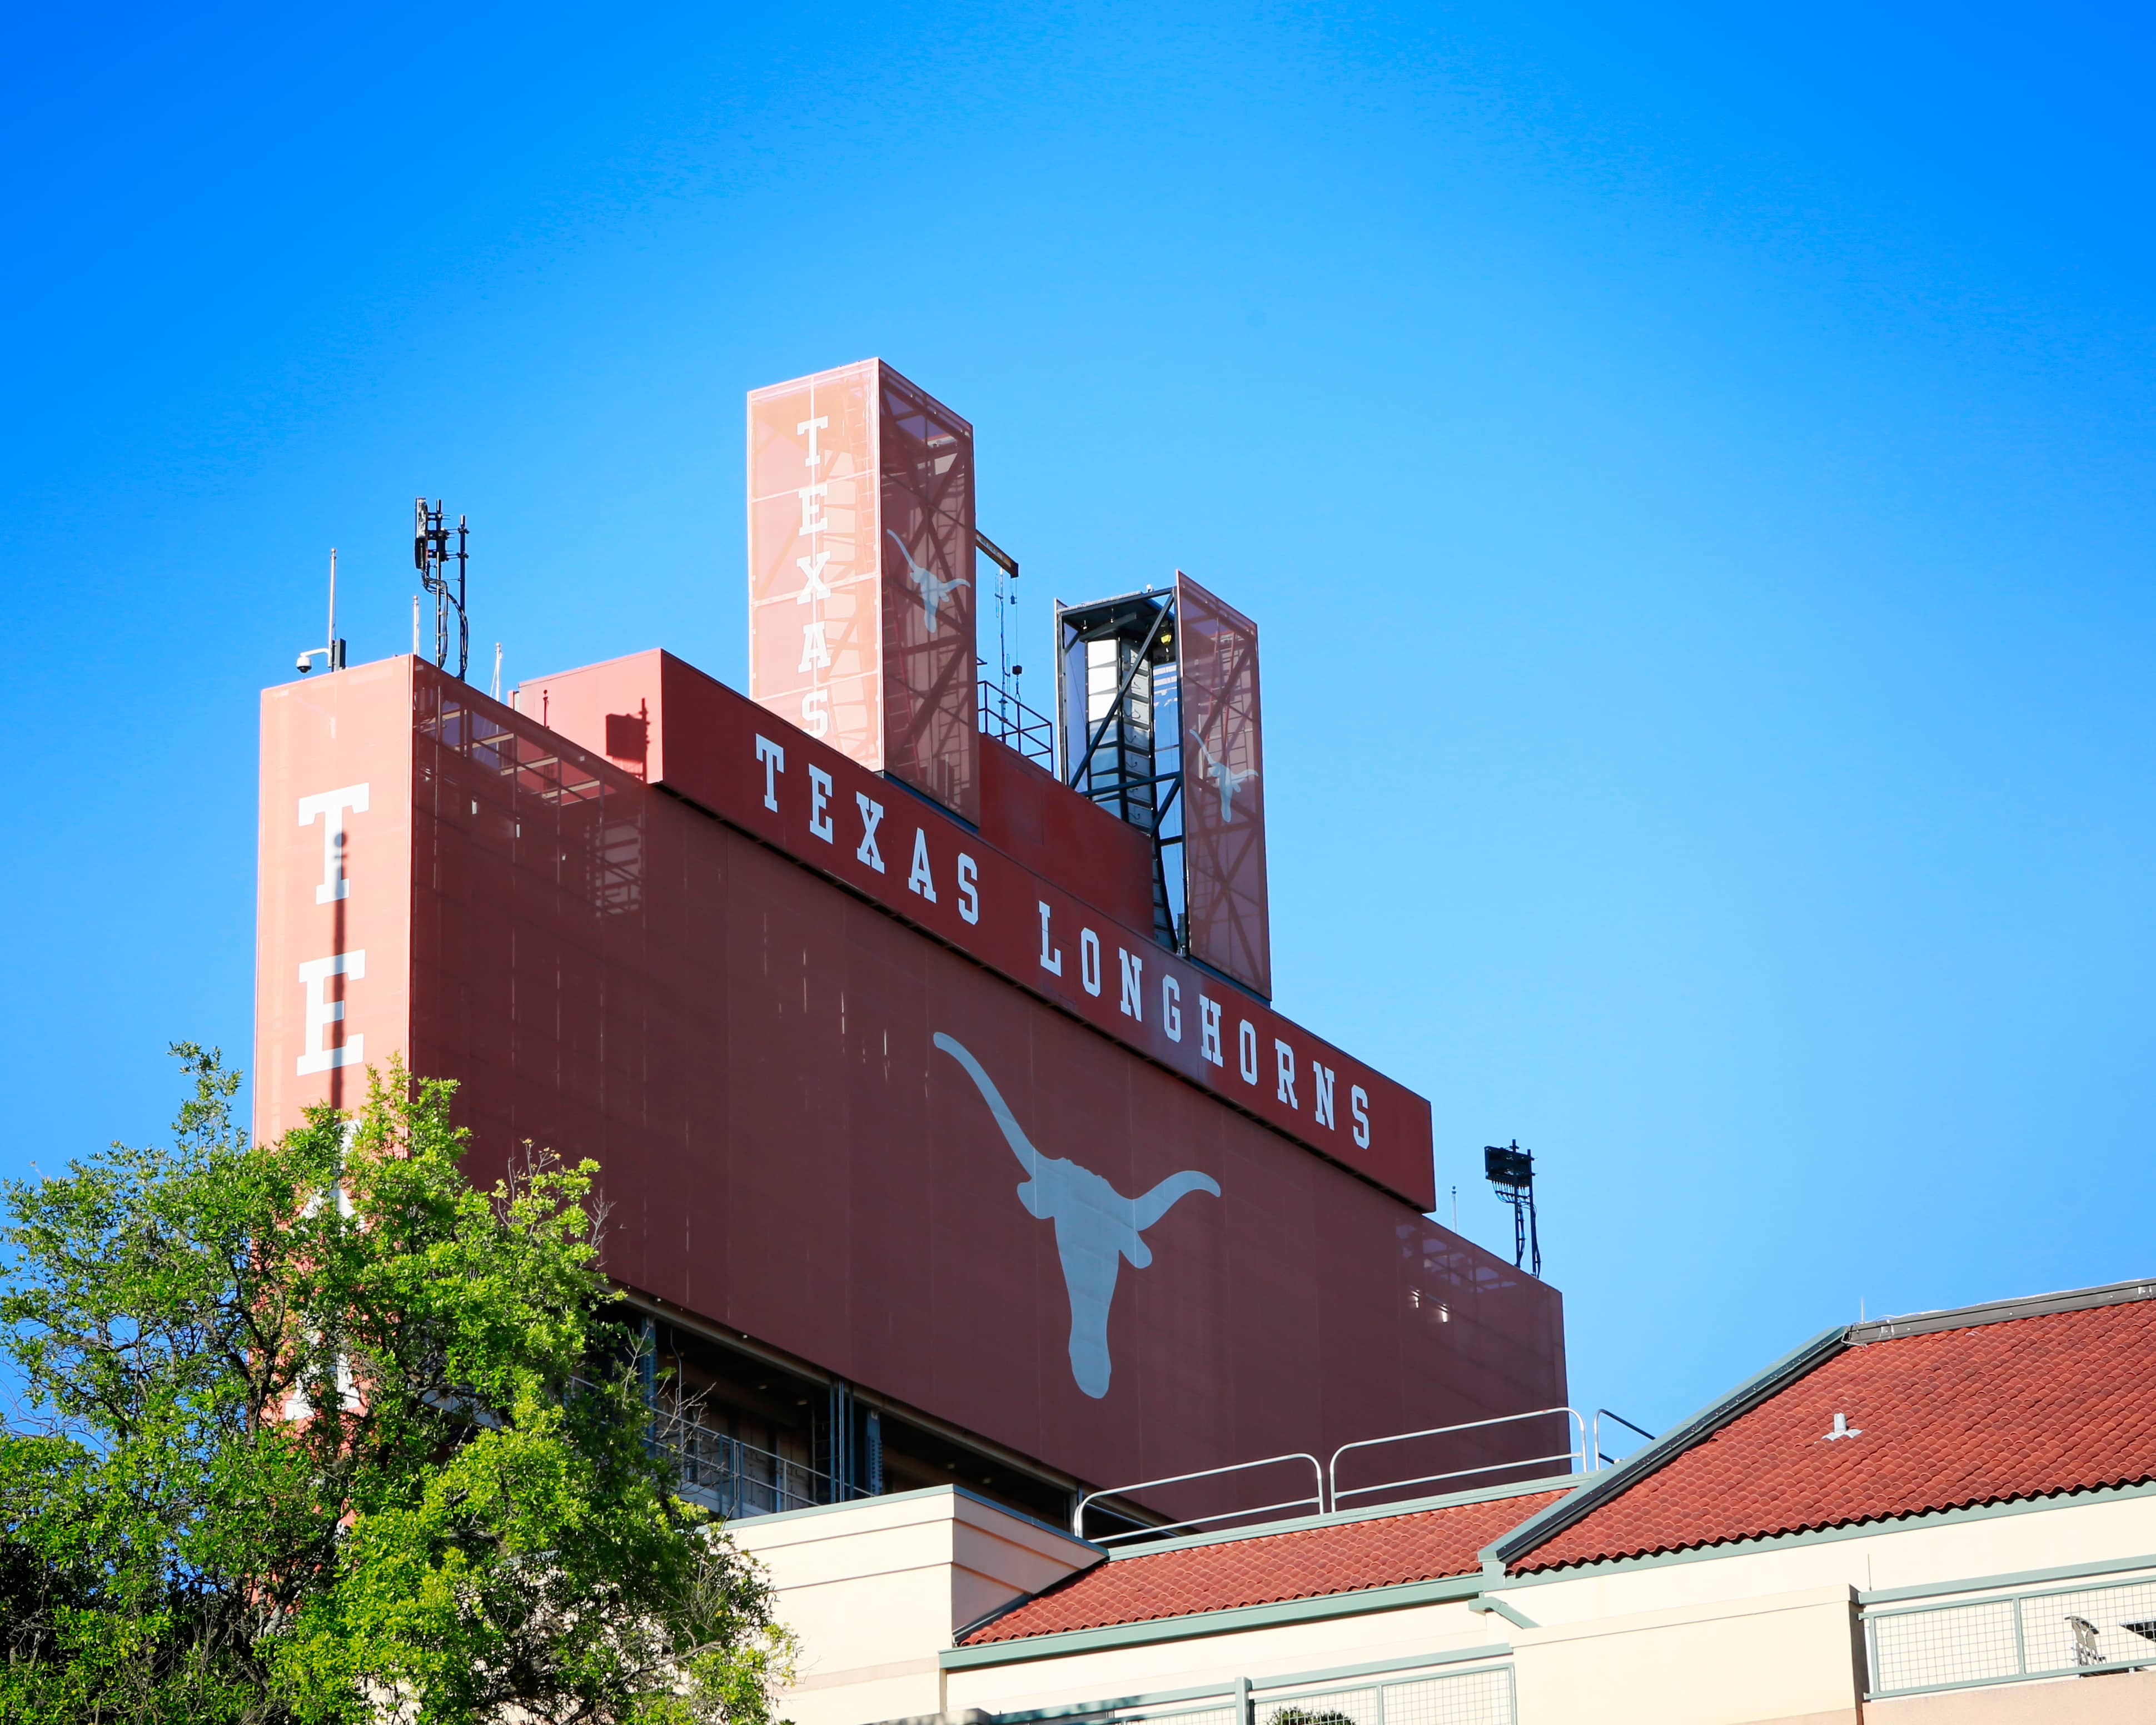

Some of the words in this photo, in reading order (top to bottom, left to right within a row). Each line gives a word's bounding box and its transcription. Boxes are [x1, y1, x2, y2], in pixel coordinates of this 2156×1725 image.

[796, 415, 831, 739] TEXAS
[755, 733, 979, 926] TEXAS
[1038, 900, 1370, 1150] LONGHORNS
[285, 782, 370, 1548] TEA
